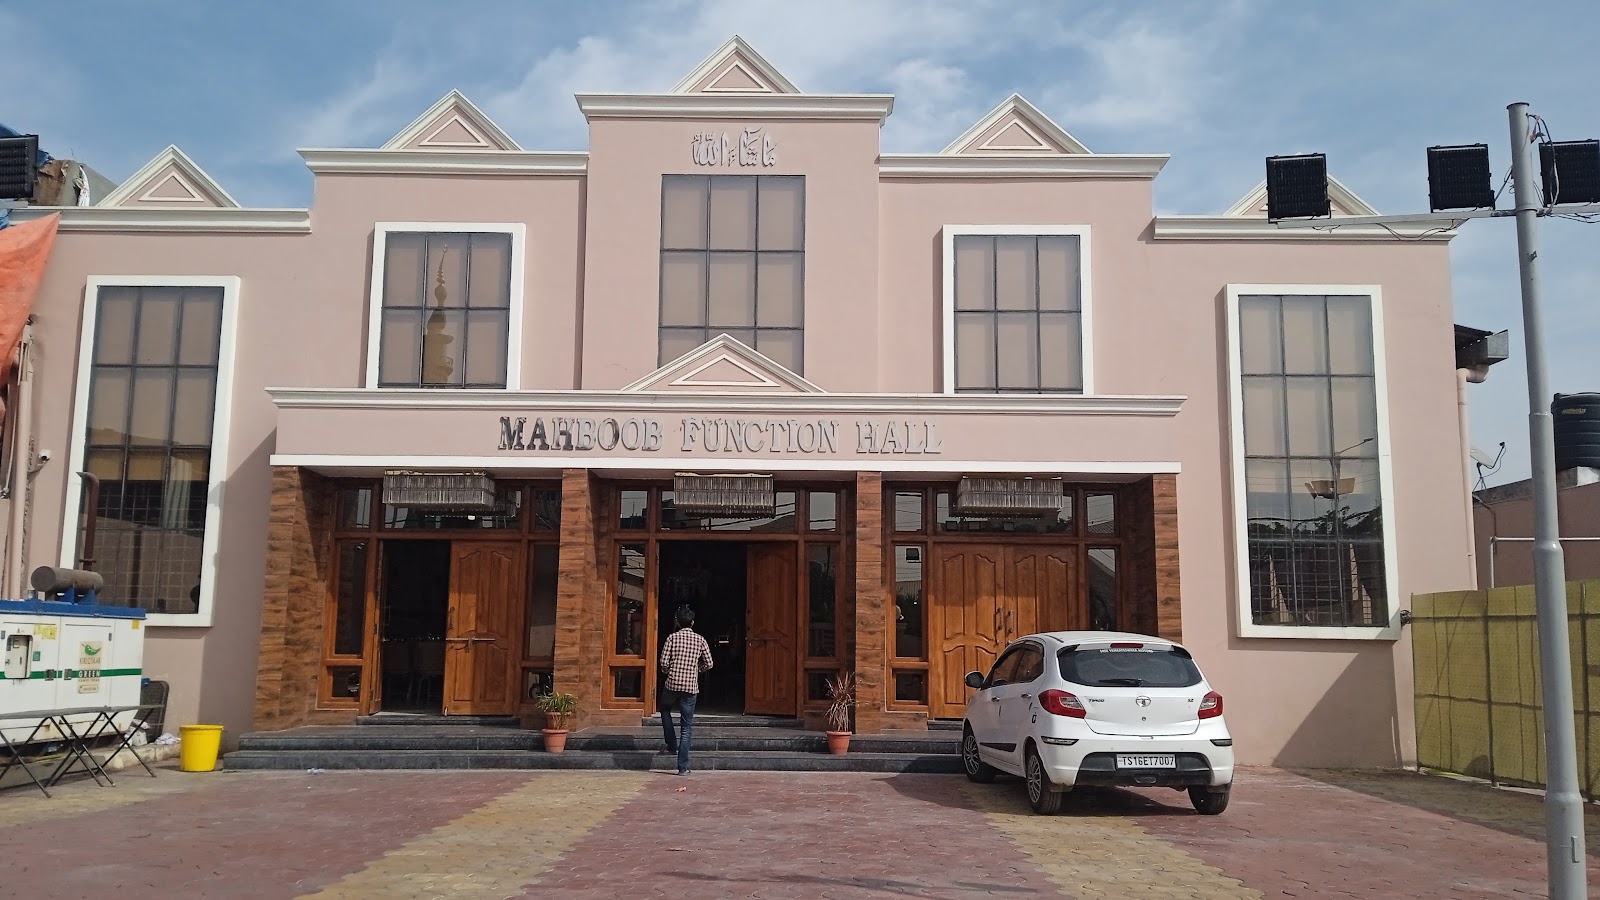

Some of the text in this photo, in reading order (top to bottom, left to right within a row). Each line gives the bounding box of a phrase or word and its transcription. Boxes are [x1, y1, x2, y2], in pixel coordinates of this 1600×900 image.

[498, 416, 942, 454] MAHBOOB FUNCTION HALL
[78, 670, 101, 678] GREEN
[1121, 756, 1174, 766] TS16ET7007
